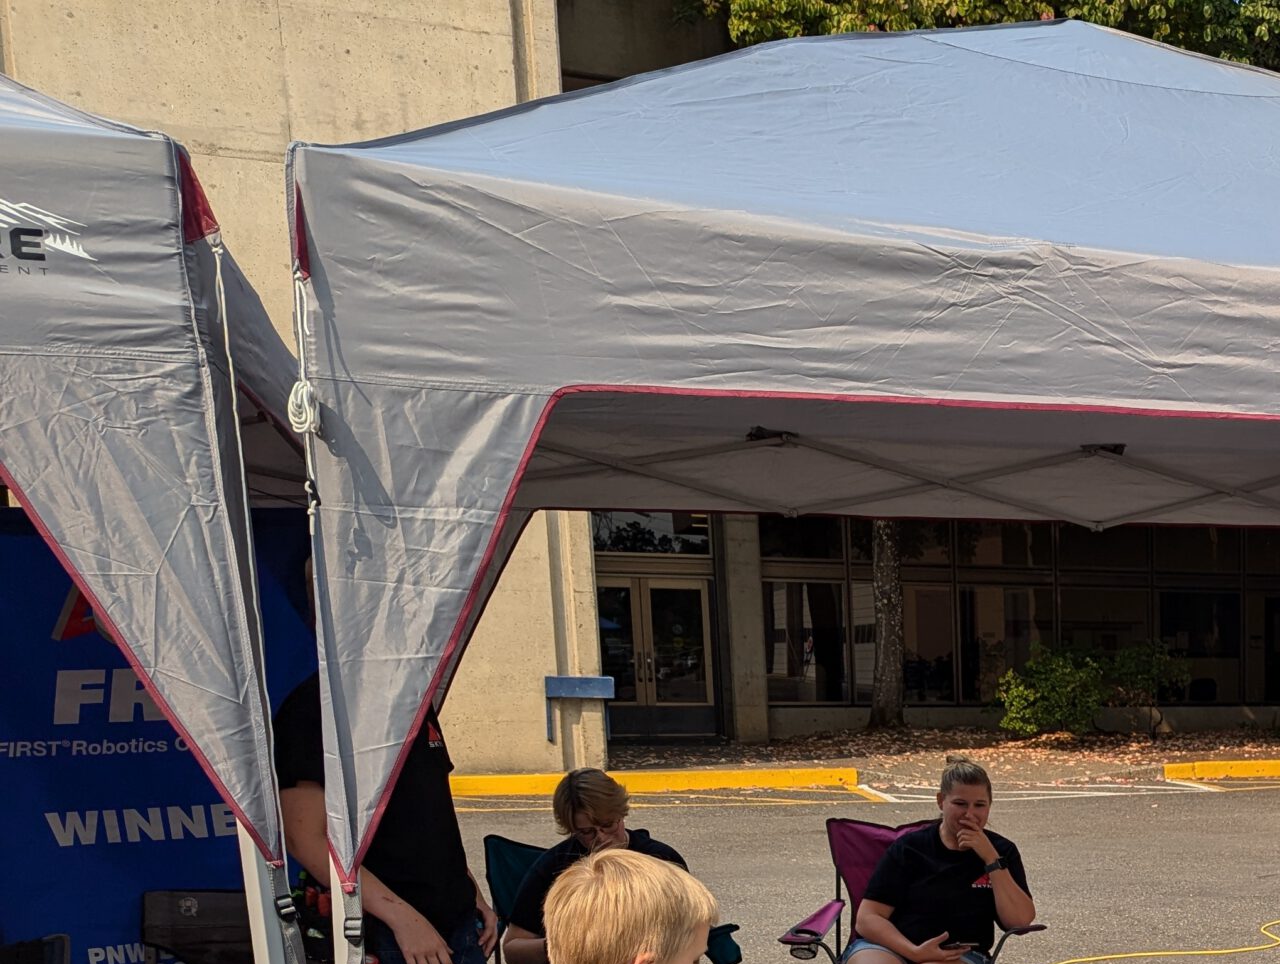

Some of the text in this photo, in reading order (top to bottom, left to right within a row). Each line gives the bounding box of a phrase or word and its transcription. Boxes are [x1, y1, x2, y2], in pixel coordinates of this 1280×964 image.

[0, 227, 46, 261] E
[71, 738, 168, 756] Robotics
[44, 803, 238, 847] WINNE
